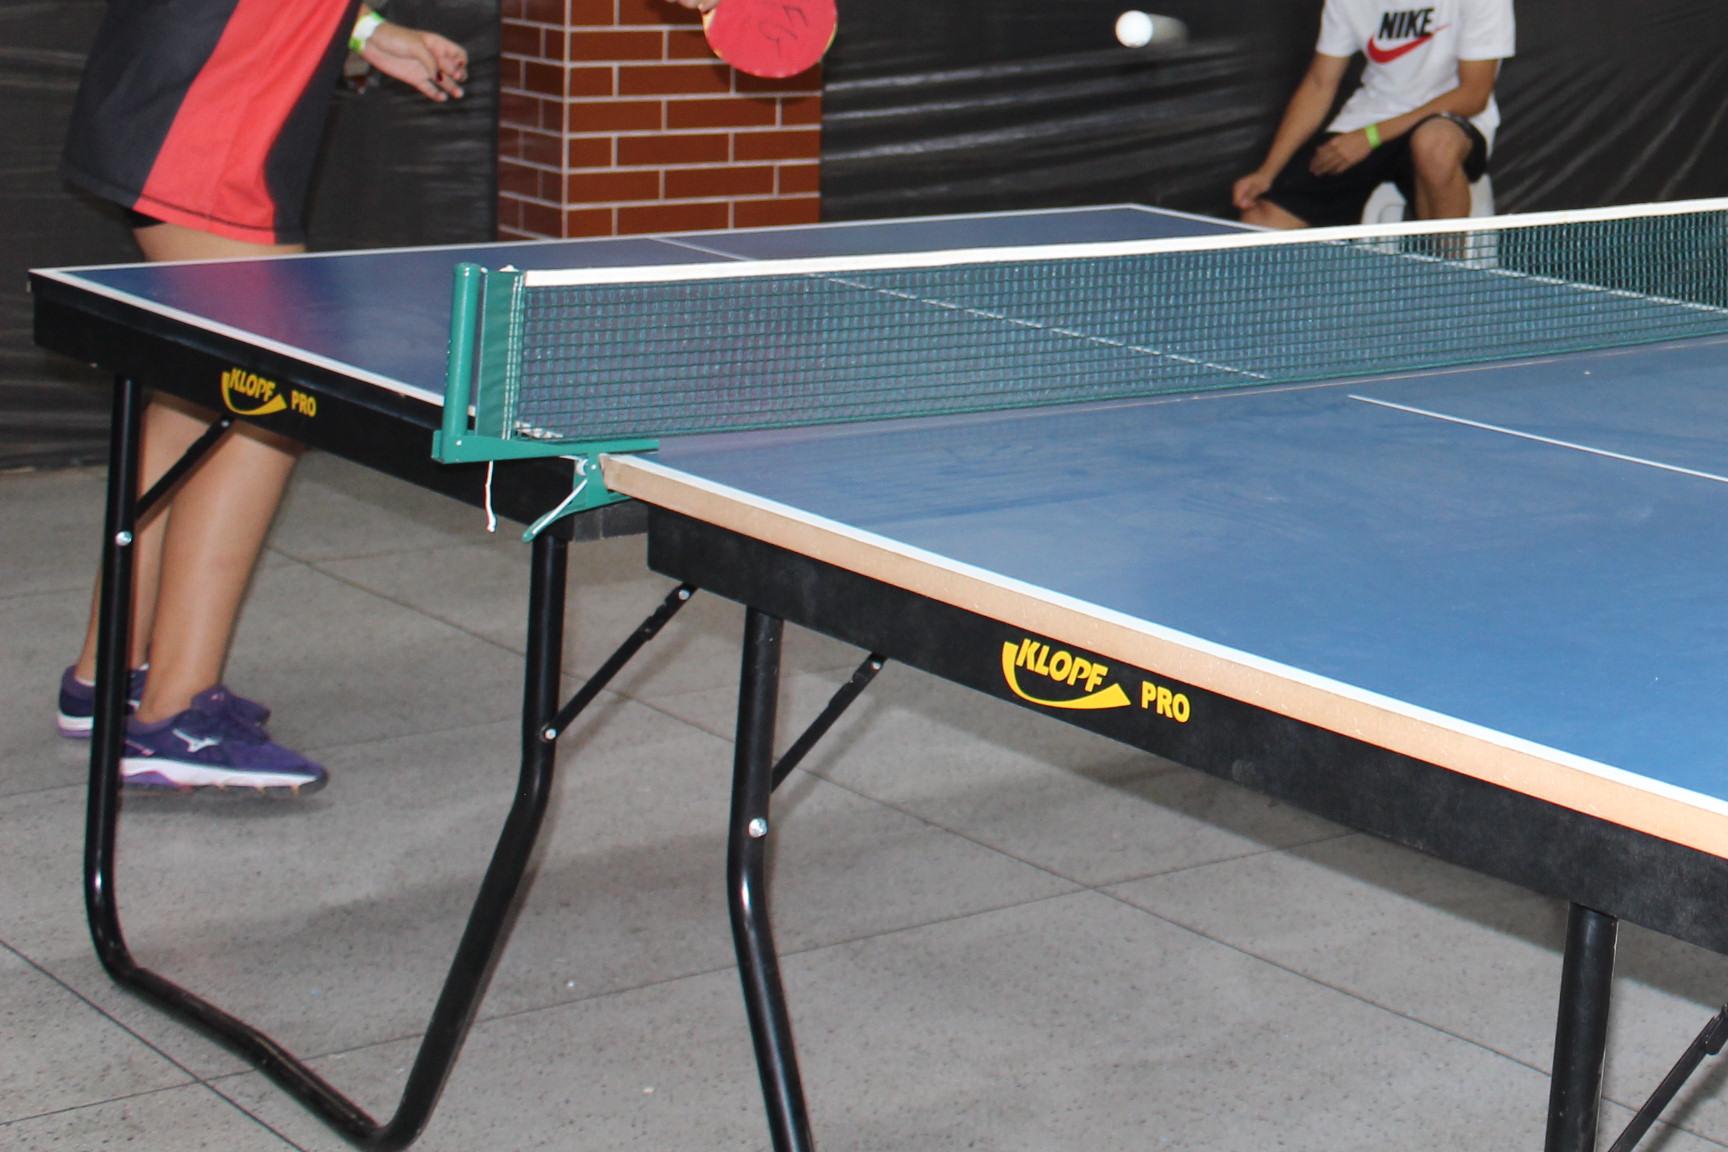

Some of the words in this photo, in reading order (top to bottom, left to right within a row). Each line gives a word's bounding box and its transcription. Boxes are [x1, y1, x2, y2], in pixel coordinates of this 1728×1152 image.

[1379, 8, 1434, 39] NIKE
[230, 368, 276, 402] KLOPF
[291, 390, 316, 417] PRO
[1015, 638, 1108, 692] KLOPF
[1141, 680, 1190, 723] PRO
